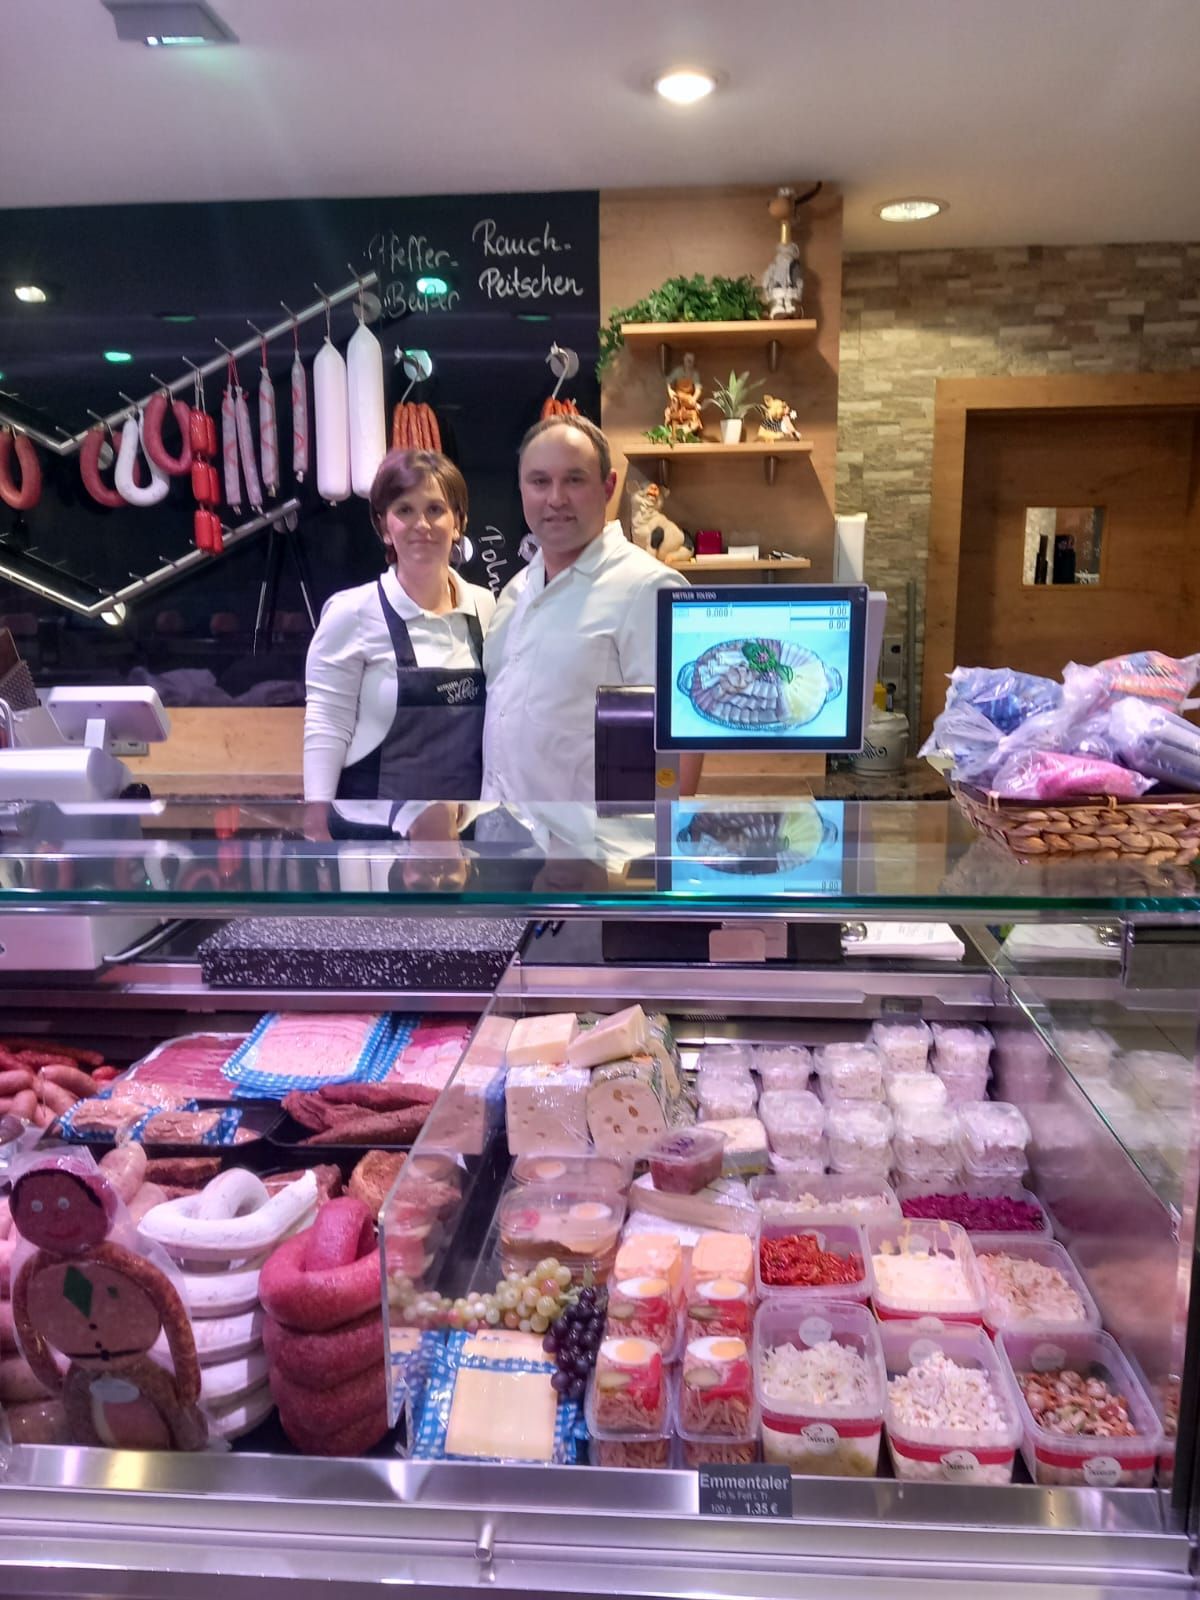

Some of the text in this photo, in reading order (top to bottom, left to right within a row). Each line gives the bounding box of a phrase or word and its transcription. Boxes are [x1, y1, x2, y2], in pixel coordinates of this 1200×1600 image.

[472, 218, 571, 256] Rauch-
[479, 264, 584, 299] Peitschen
[700, 1472, 789, 1490] Emmentaler
[711, 1503, 725, 1513] 100
[745, 1502, 768, 1515] 1,35
[770, 1502, 779, 1515] €
